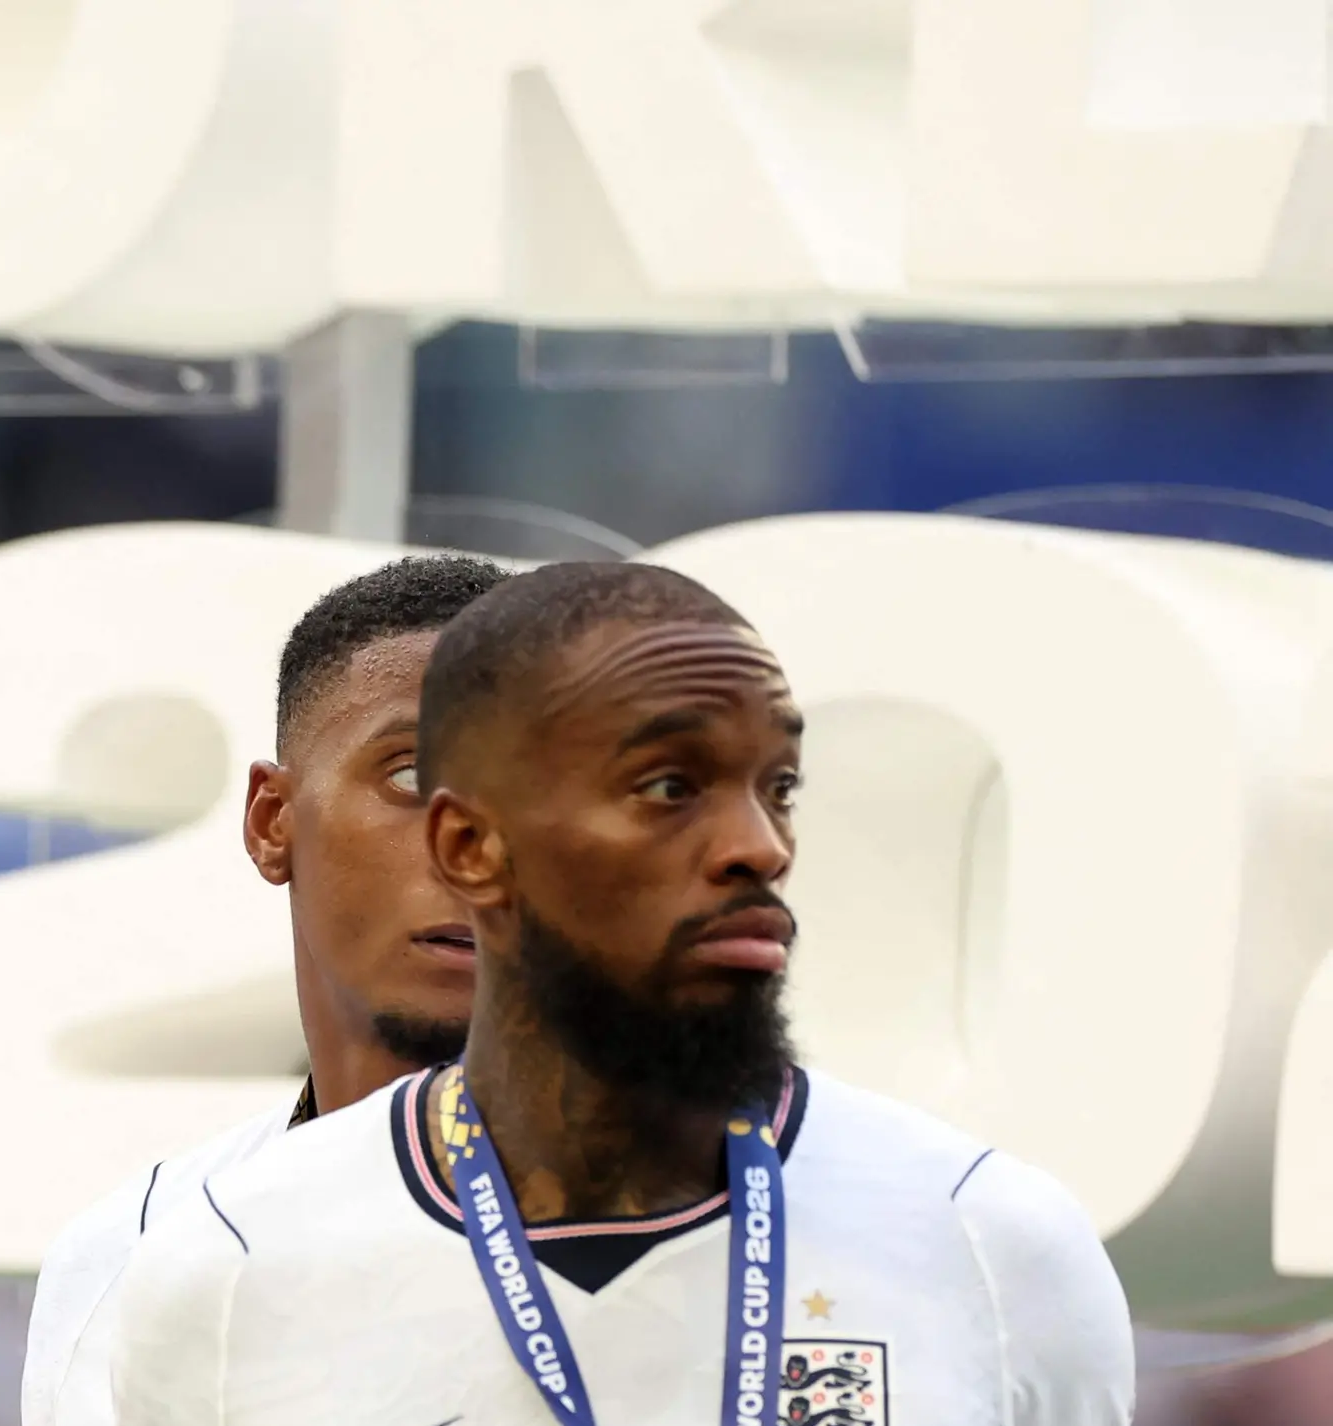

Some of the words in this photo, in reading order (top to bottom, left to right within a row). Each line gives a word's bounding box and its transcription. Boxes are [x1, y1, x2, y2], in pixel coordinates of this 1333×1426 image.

[469, 1171, 504, 1235] FIFA
[744, 1166, 773, 1265] 2026
[485, 1228, 543, 1332] WORLD
[742, 1265, 770, 1328] CUP
[526, 1332, 568, 1394] CUP
